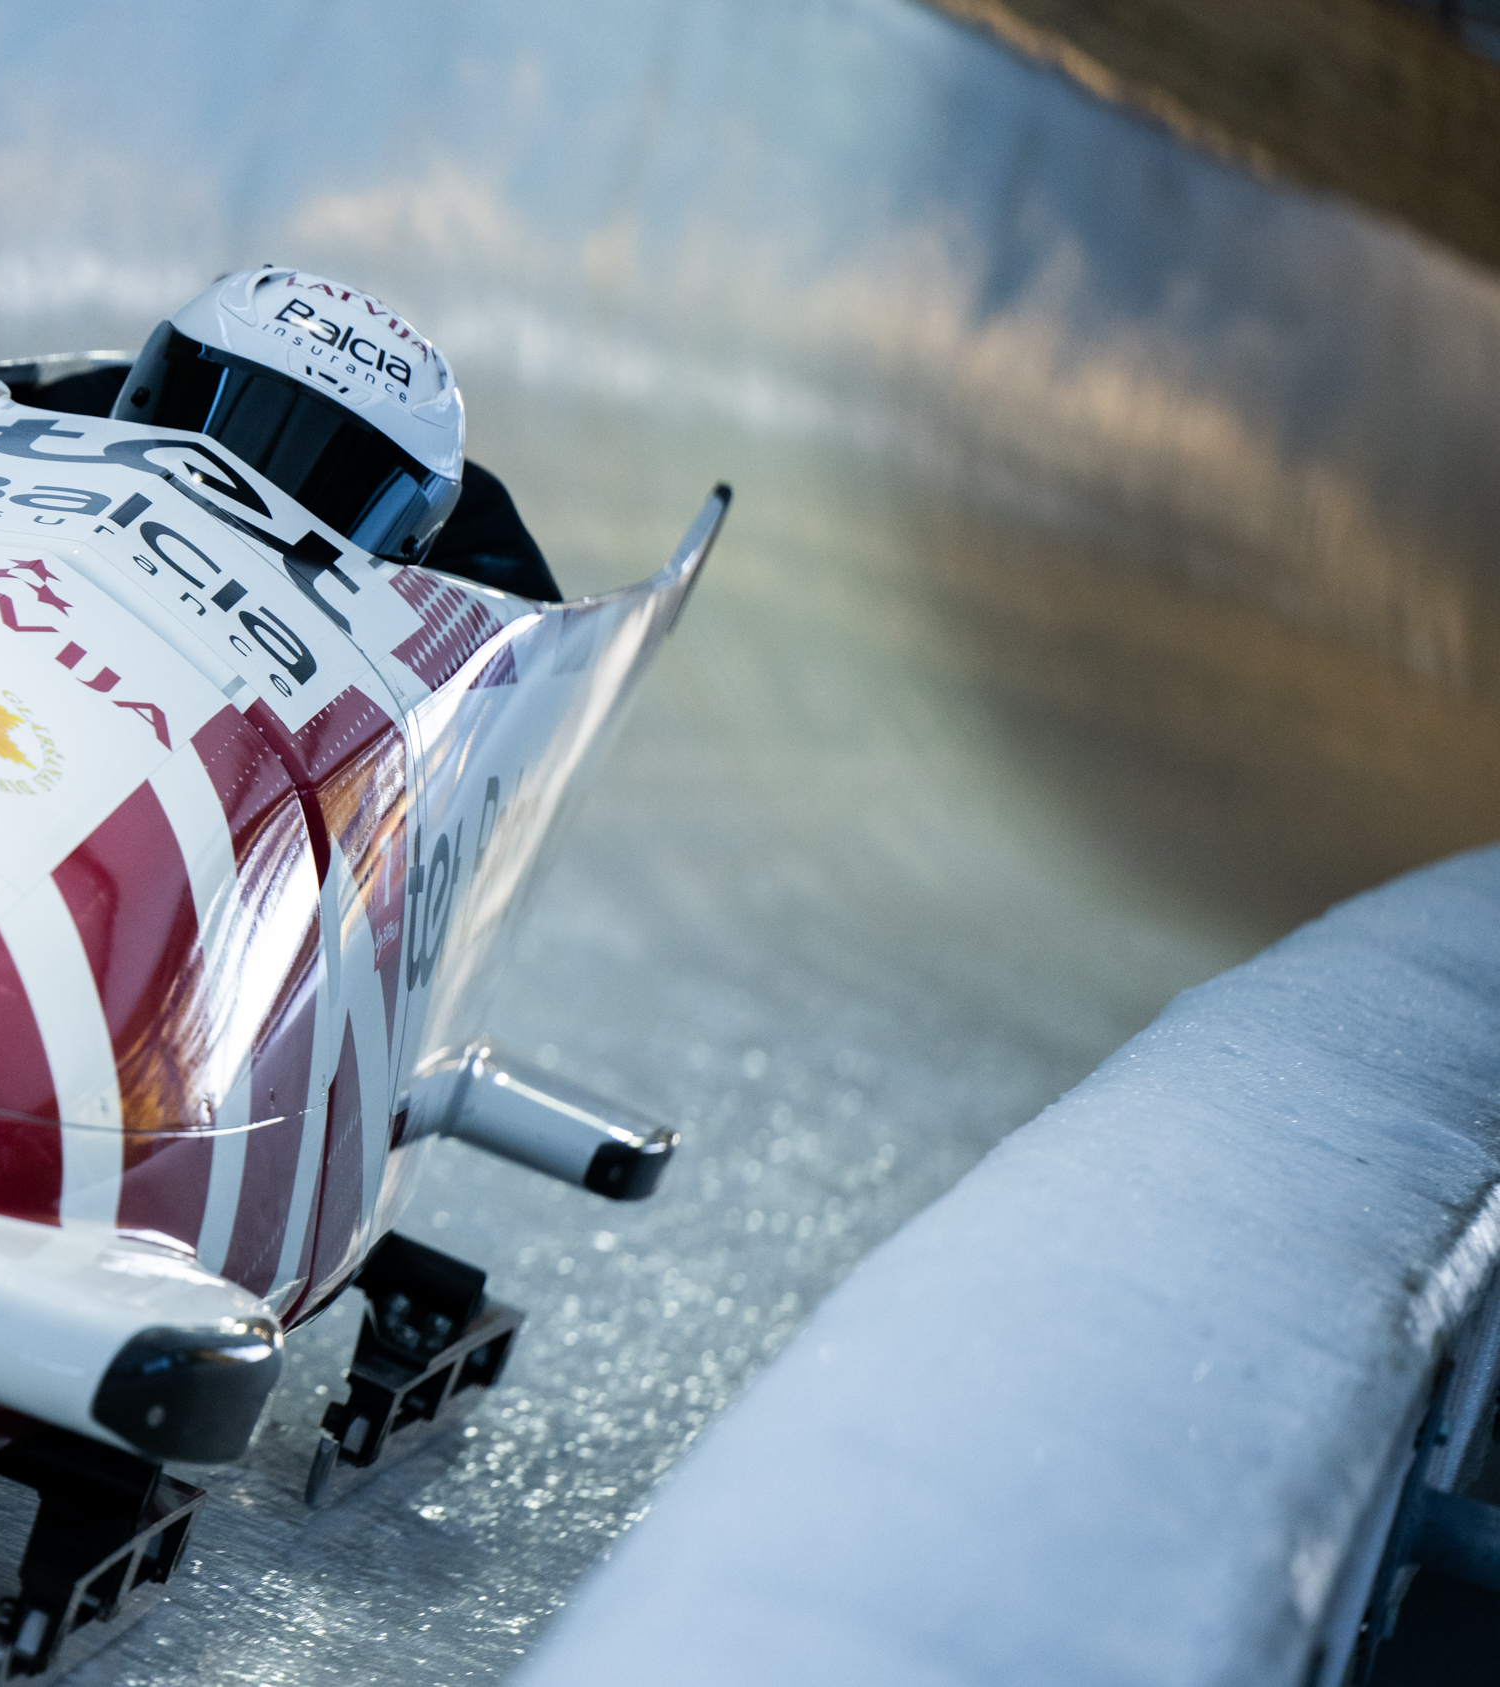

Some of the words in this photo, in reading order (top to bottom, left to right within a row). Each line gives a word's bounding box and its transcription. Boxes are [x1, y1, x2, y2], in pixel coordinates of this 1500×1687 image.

[274, 298, 412, 388] Balcia
[286, 277, 429, 362] LATVIJA
[262, 323, 407, 403] insurance
